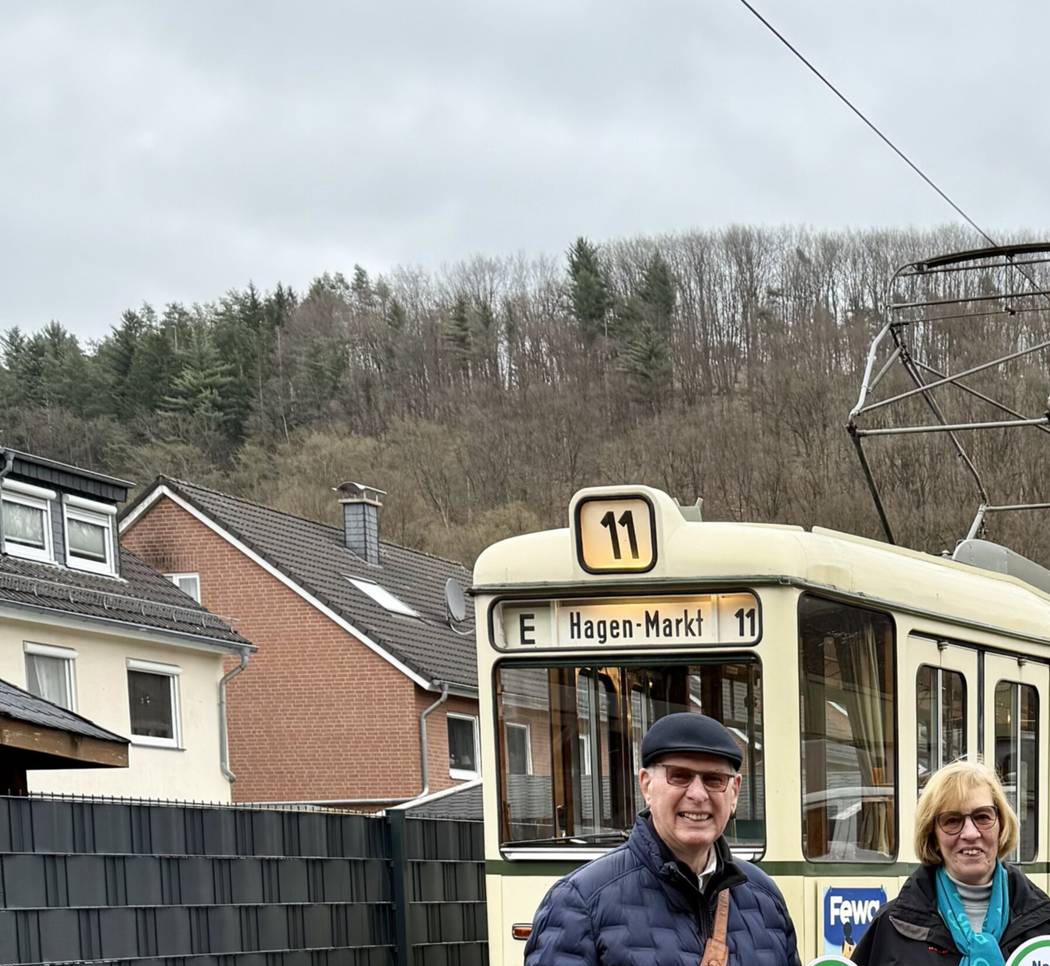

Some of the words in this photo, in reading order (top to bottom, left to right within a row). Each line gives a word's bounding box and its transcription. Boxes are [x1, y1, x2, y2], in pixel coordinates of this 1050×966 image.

[600, 510, 640, 560] 11
[519, 613, 535, 645] E
[570, 608, 704, 644] Hagen-Markt
[734, 608, 756, 638] 11
